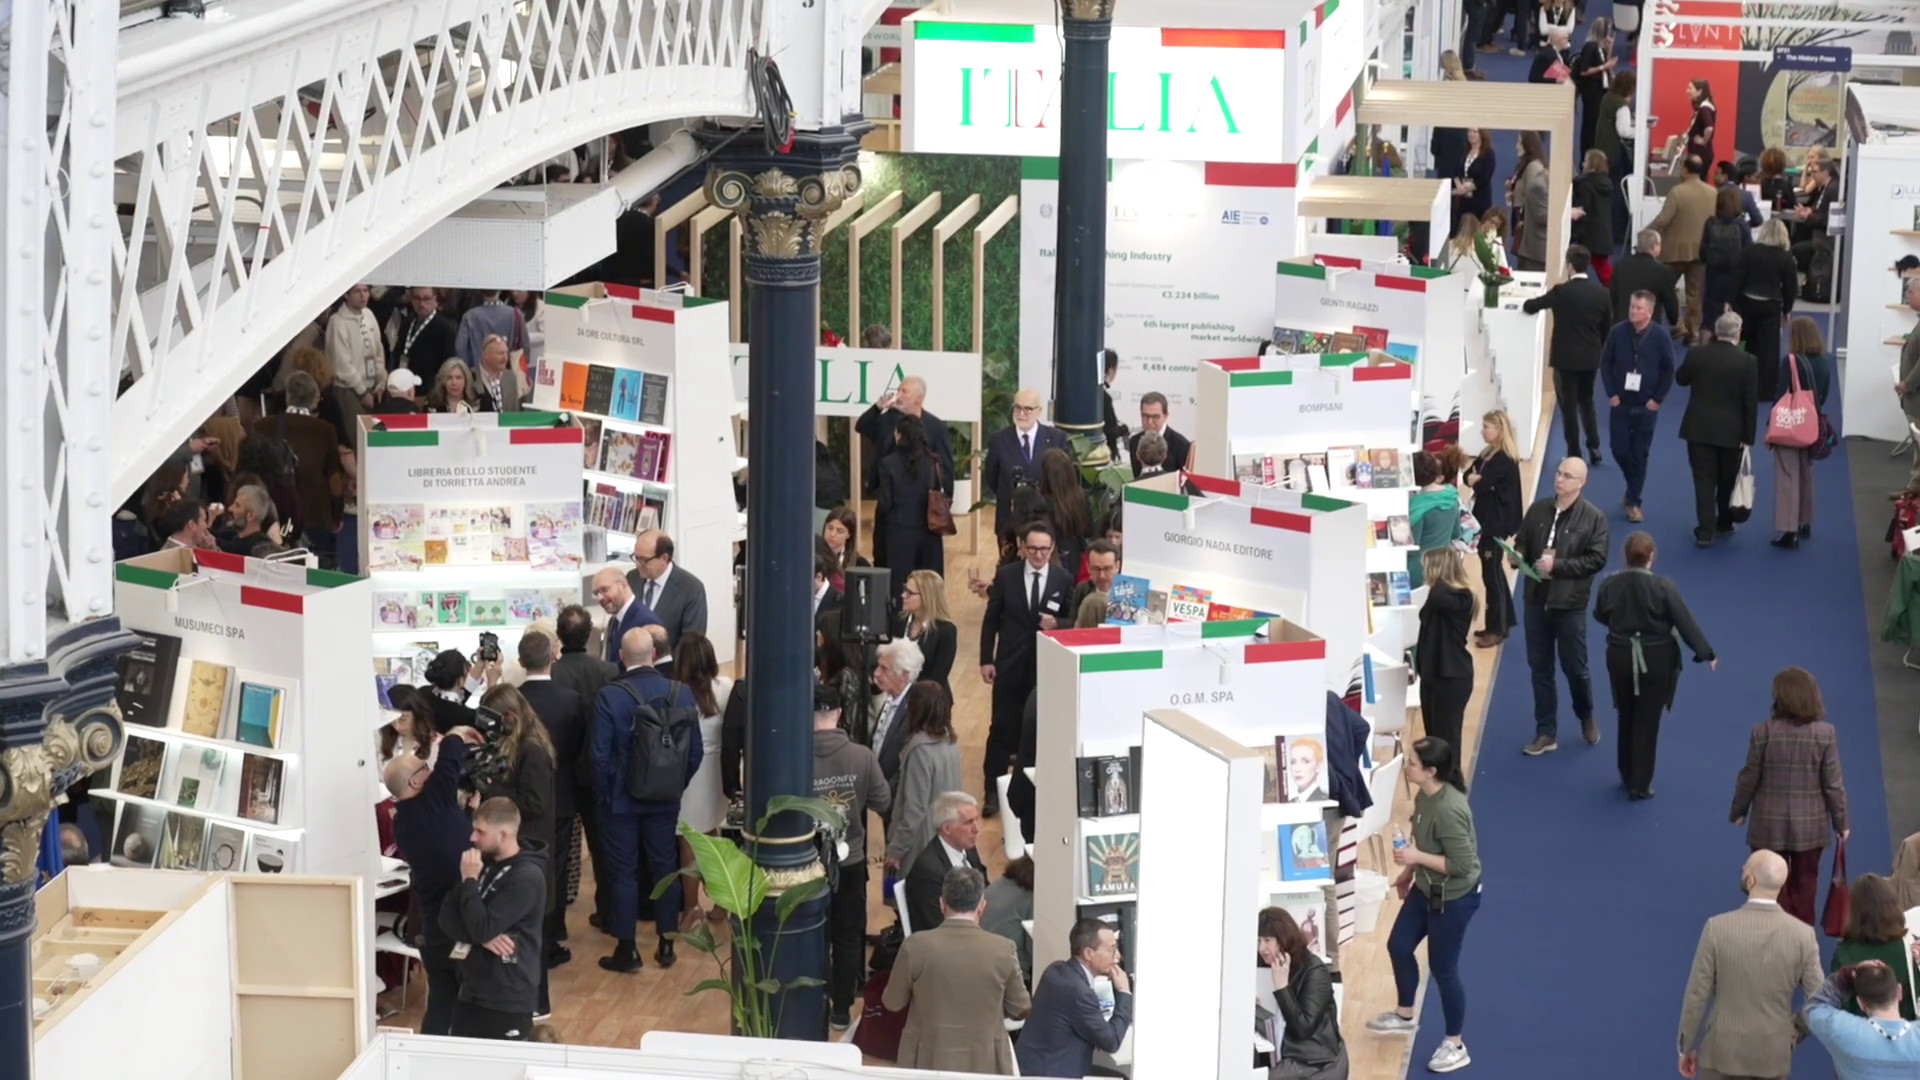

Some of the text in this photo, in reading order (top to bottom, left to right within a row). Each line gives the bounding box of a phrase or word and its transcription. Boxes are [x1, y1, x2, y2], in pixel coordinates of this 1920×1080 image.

[1222, 210, 1240, 221] AIE
[1039, 248, 1056, 257] Ital
[1129, 251, 1172, 263] Industry
[1193, 292, 1219, 301] billion
[1319, 297, 1379, 313] GIUNTI RAGAZZI
[1143, 320, 1236, 333] 6th largest publishing
[576, 327, 644, 347] 24 ORE CULTURA SRL
[1190, 333, 1221, 342] market
[1142, 363, 1166, 372] 8,484
[1299, 402, 1344, 414] BOMPIANI
[408, 465, 538, 477] LIBRERIA DELLO STUDENTE
[423, 477, 526, 488] DI TORRETTA ANDREA
[1164, 531, 1274, 560] GIORGIO NADA EDITORE
[1173, 602, 1206, 618] VESPA
[174, 616, 246, 641] MUSUMECI SPA
[1170, 690, 1234, 706] O.G.M. SPA
[813, 774, 858, 787] RAGONFLY
[1095, 883, 1137, 893] SAMURA
